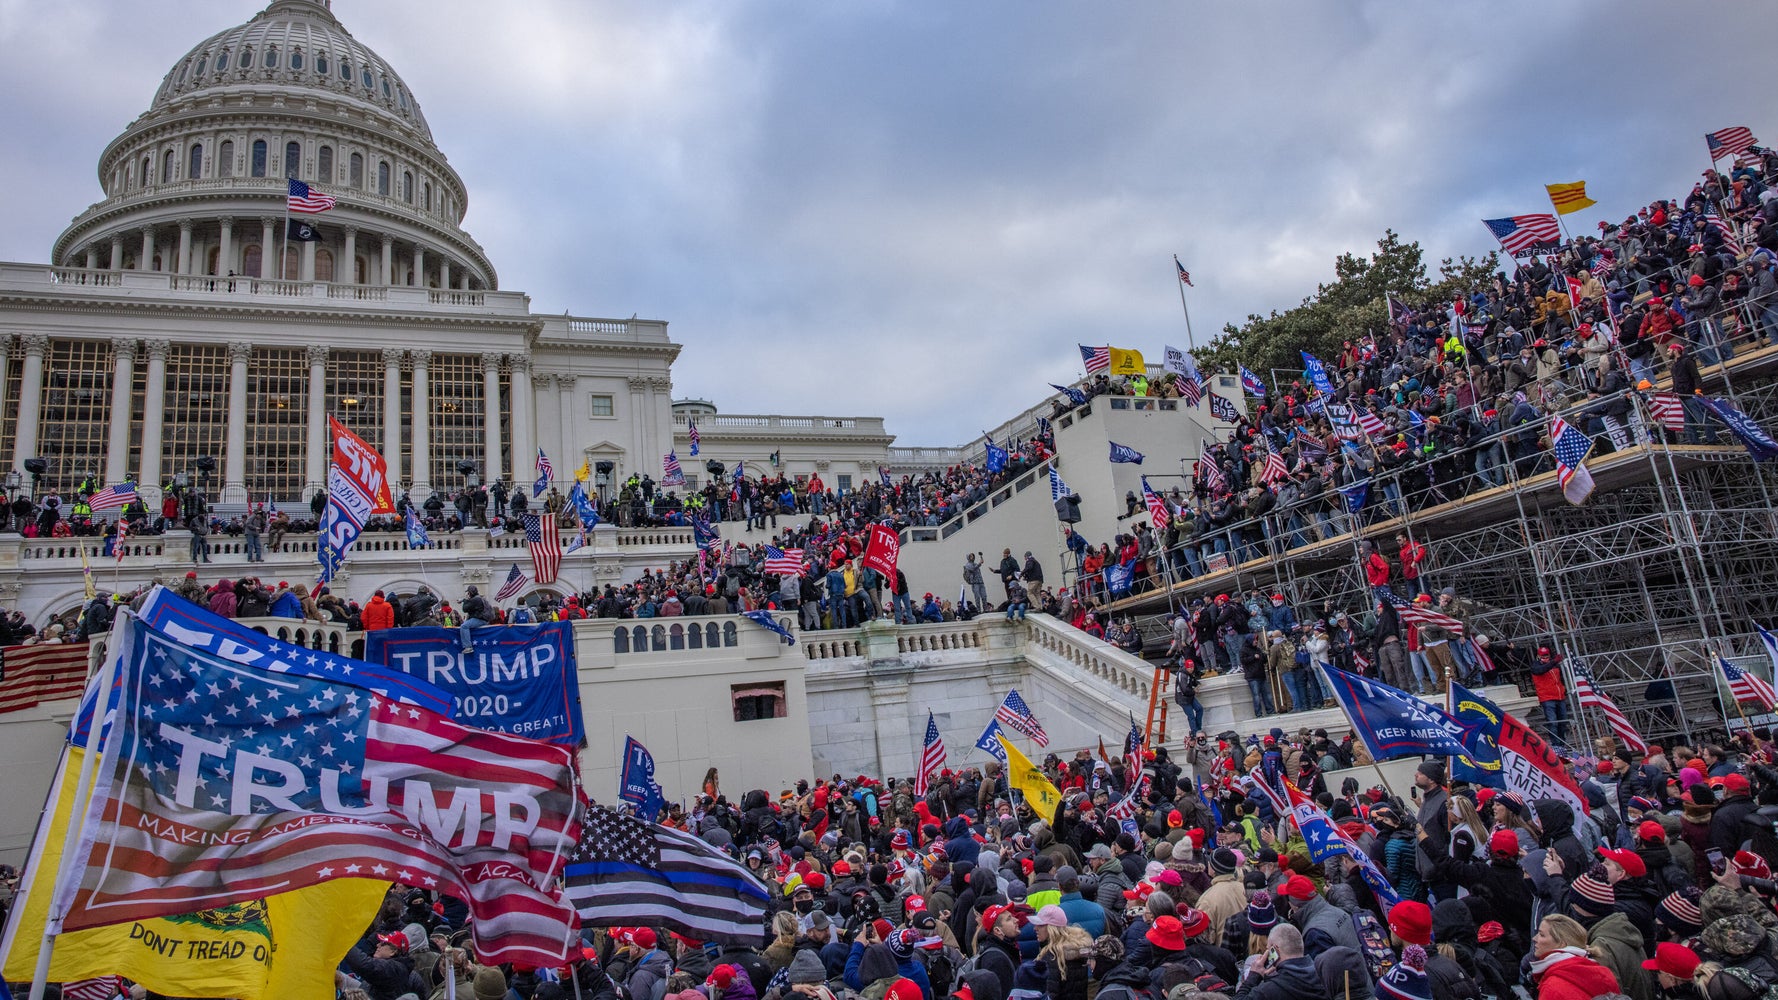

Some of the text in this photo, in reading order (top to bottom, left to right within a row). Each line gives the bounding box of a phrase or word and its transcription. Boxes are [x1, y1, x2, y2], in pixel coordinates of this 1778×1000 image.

[392, 643, 555, 685] TRUMP
[513, 714, 564, 734] GREAT!
[1376, 728, 1407, 740] KEEP
[159, 722, 541, 851] TRUMP
[139, 813, 251, 845] MAKING
[262, 814, 393, 838] AMERICA
[130, 922, 183, 958] DONT
[187, 941, 246, 960] TREAD
